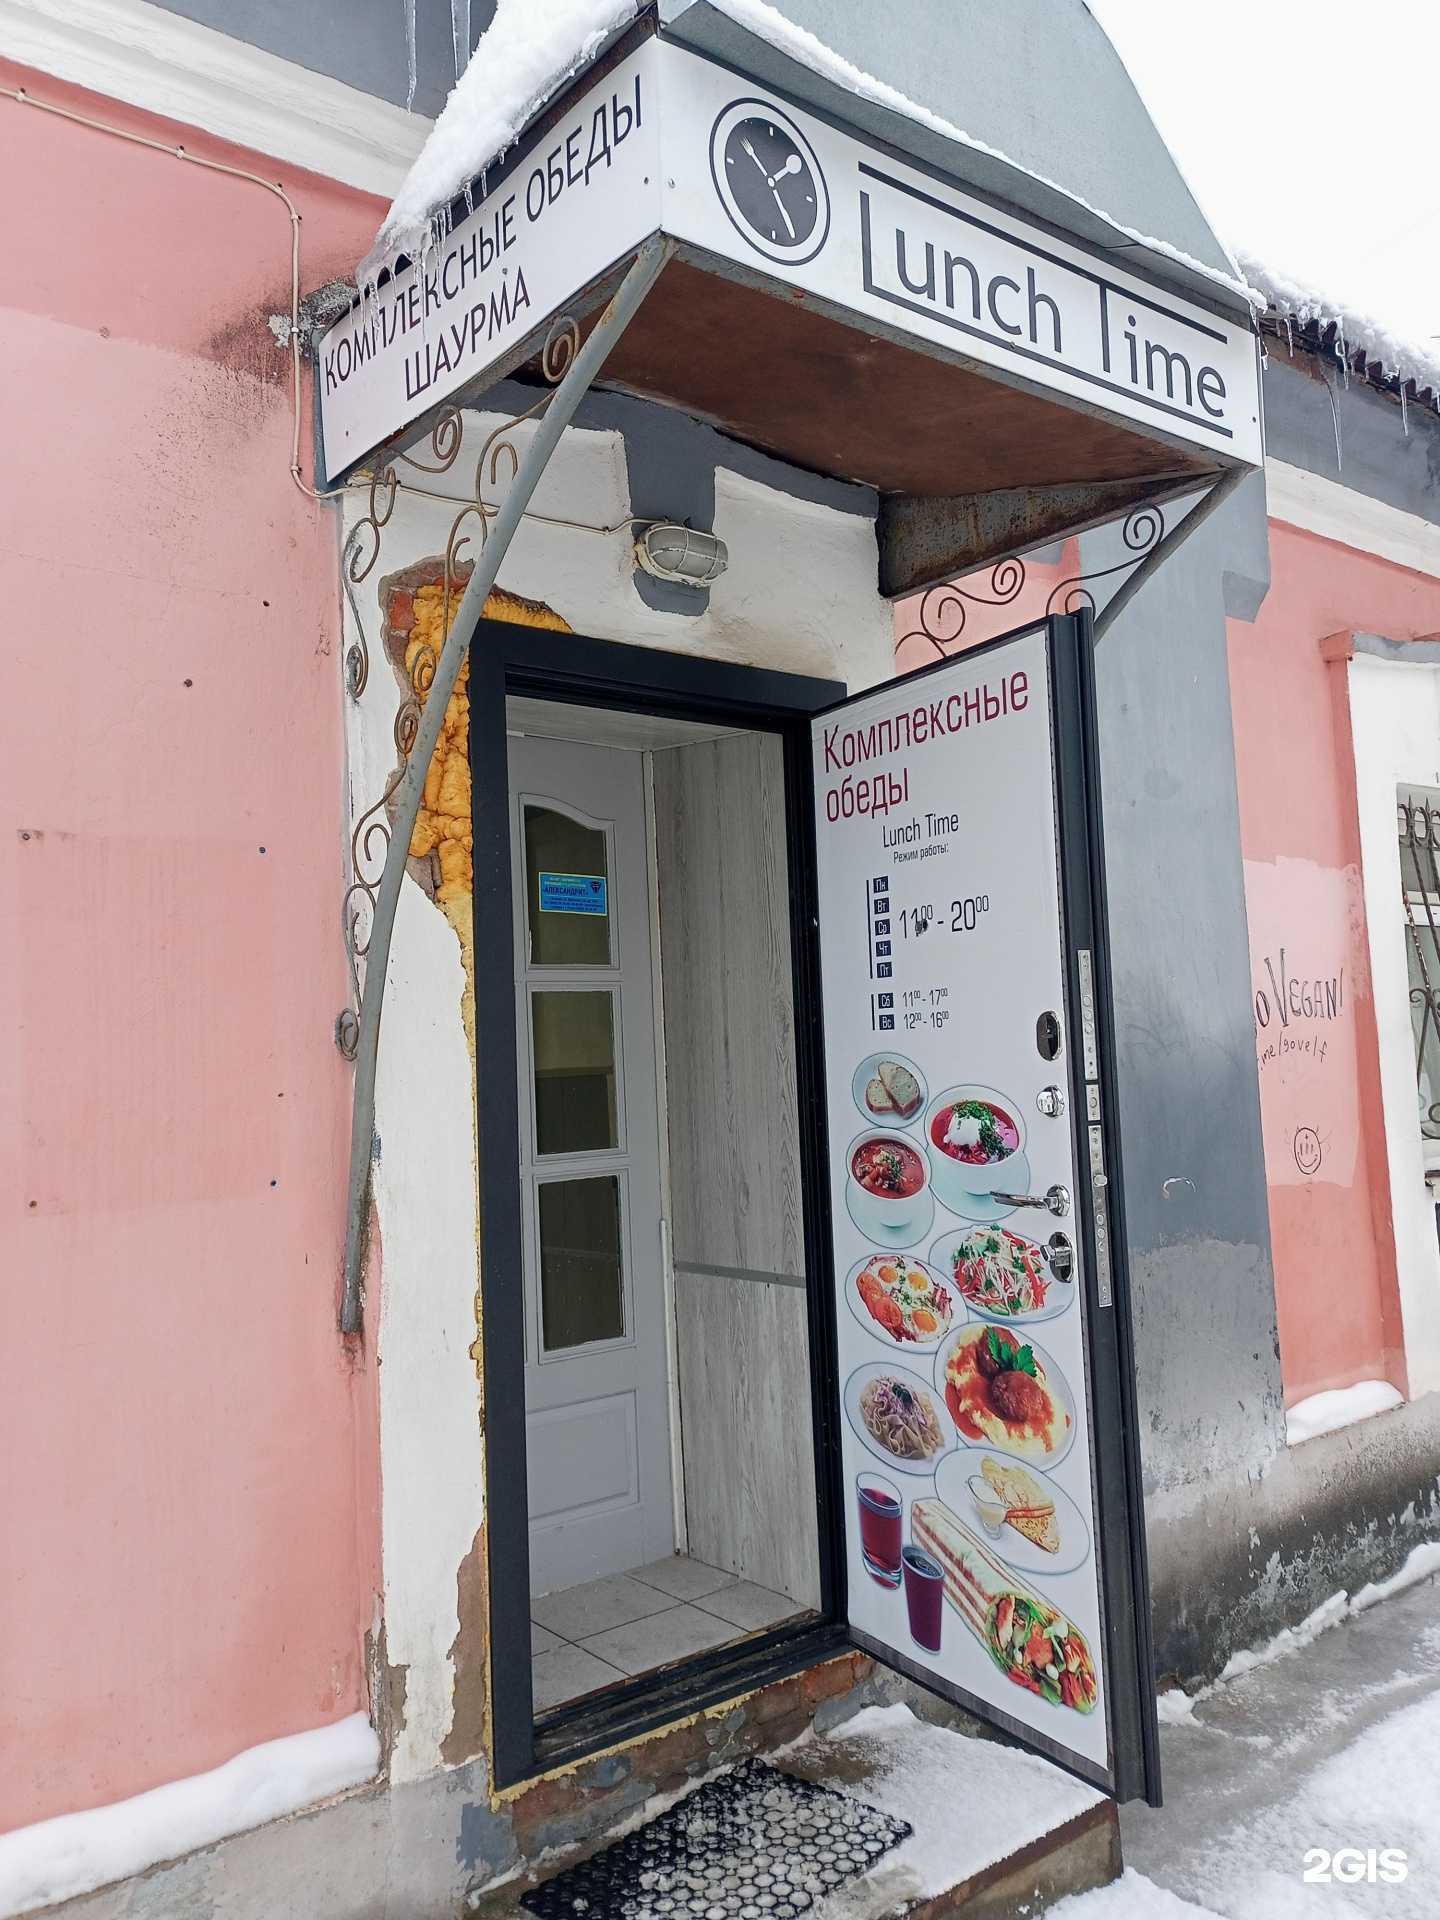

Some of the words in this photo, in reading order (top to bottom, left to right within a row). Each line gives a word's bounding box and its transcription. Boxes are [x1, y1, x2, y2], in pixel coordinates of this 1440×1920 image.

[326, 193, 517, 397] КОМПЛЕКСНЫЕ
[525, 74, 642, 222] ОБЕДЫ
[859, 189, 1062, 353] Lunch
[1099, 281, 1228, 418] Time
[404, 265, 531, 402] ШАУРМА
[823, 671, 1029, 774] Комплексные
[826, 767, 909, 823] обеды
[882, 817, 921, 849] Lunch
[925, 813, 960, 839] Time
[893, 849, 919, 864] Режим
[919, 843, 950, 861] работы:
[880, 994, 892, 1007] Сб
[881, 1016, 893, 1029] Вс
